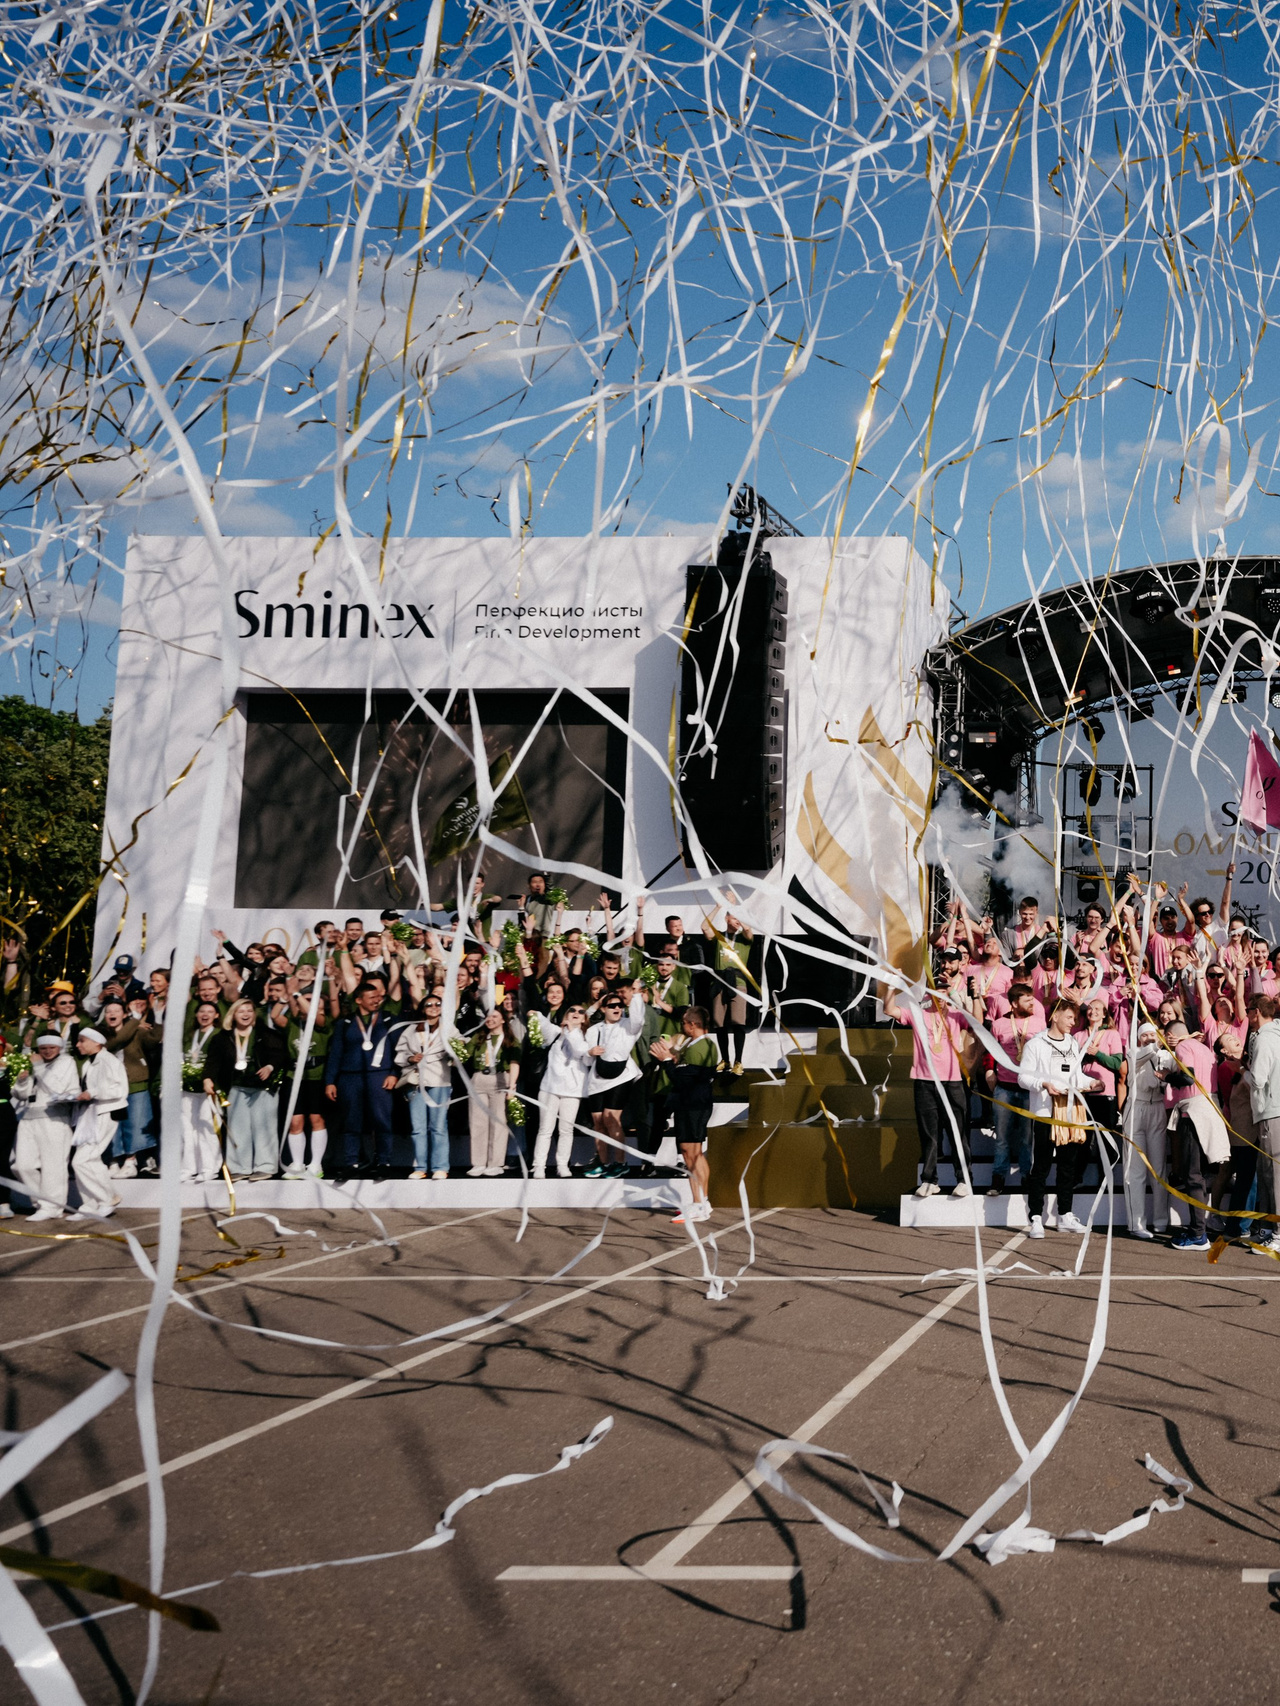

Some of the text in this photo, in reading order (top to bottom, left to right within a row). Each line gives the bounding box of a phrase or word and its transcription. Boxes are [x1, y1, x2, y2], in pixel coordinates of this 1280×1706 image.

[234, 589, 435, 639] Sminex
[475, 604, 643, 620] Перфекциоисты
[518, 625, 642, 641] Development
